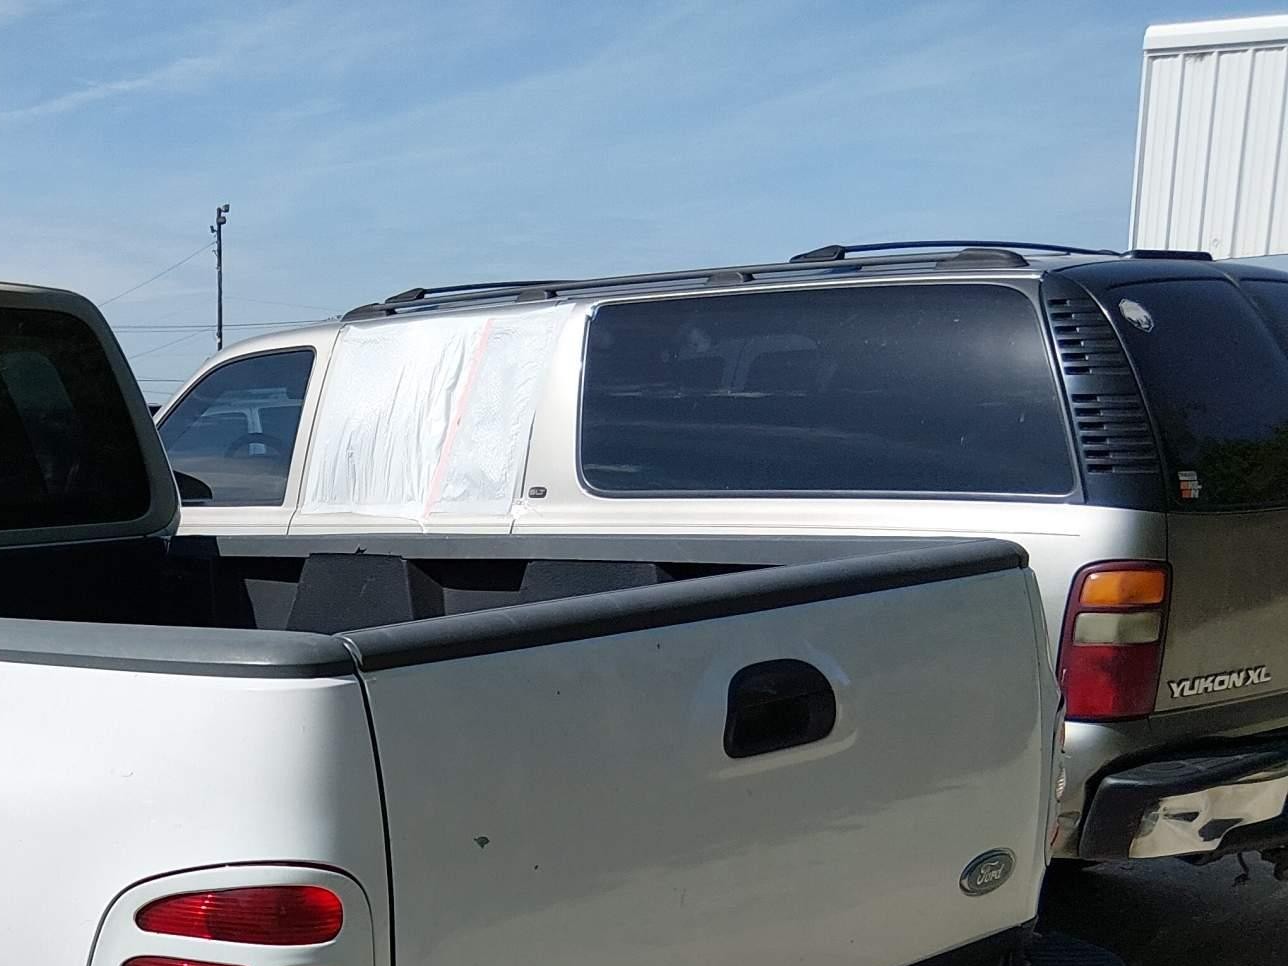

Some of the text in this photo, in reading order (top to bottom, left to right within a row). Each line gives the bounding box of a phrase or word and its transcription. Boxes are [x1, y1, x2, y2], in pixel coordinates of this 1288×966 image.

[1168, 665, 1272, 698] YUKON XL
[977, 861, 1005, 885] Ford
